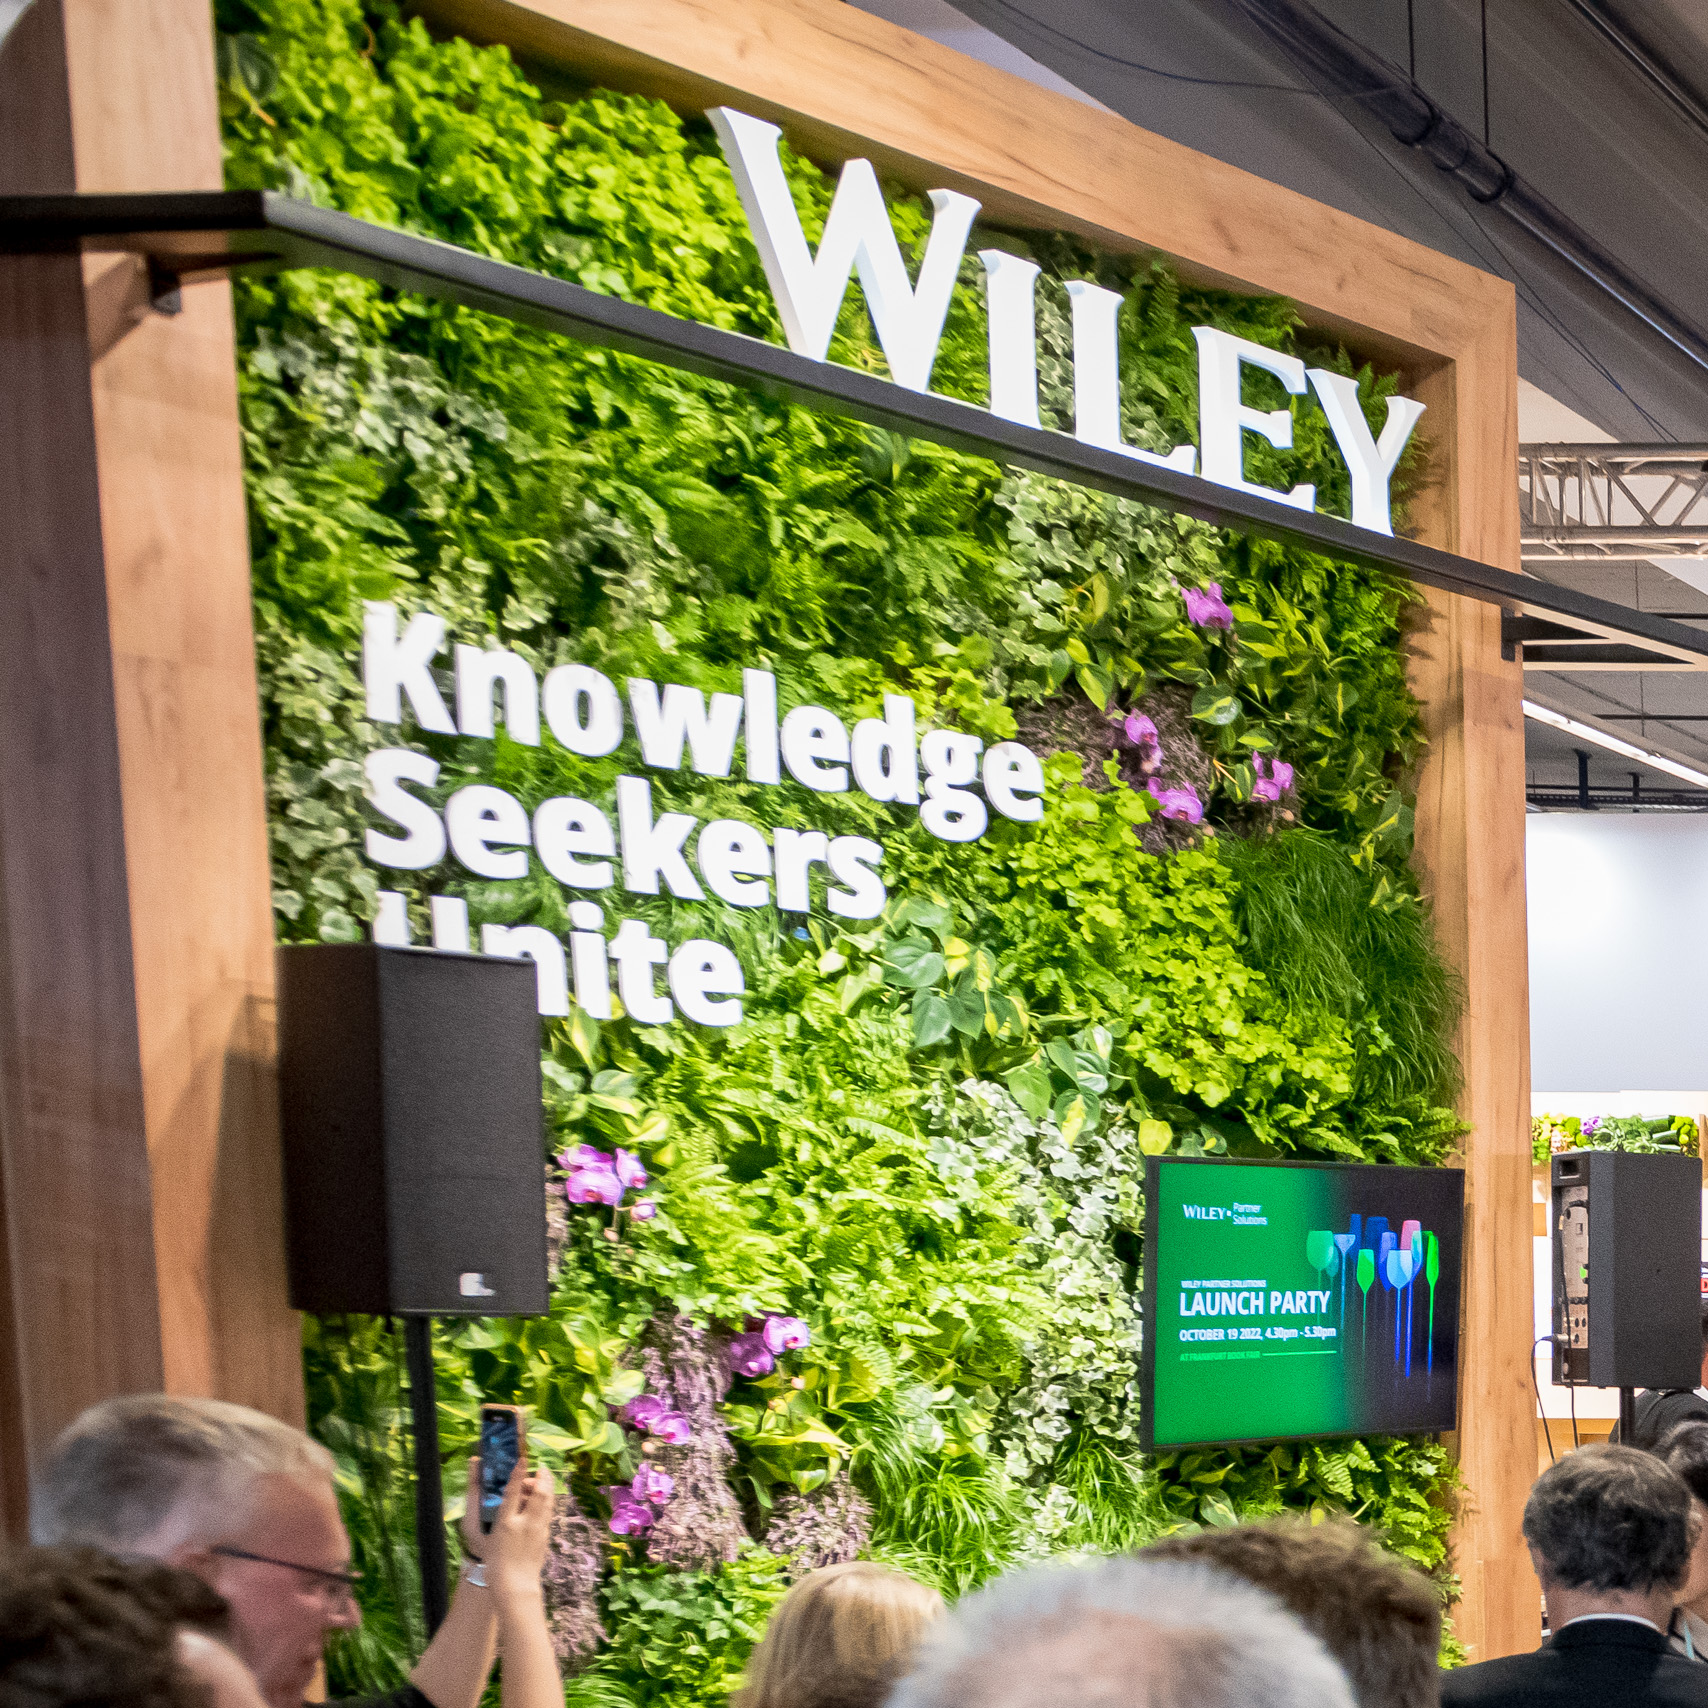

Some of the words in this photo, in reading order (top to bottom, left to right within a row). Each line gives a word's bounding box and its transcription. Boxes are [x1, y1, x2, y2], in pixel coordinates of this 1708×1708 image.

[705, 106, 1426, 537] WILEY
[362, 600, 1045, 842] Knowledge
[364, 747, 887, 920] Seekers
[1183, 1204, 1226, 1220] WILEY
[1179, 1291, 1264, 1316] LAUNCH
[1270, 1290, 1331, 1314] PARTY
[1179, 1328, 1225, 1341] OCTOBER
[1227, 1328, 1238, 1339] 19
